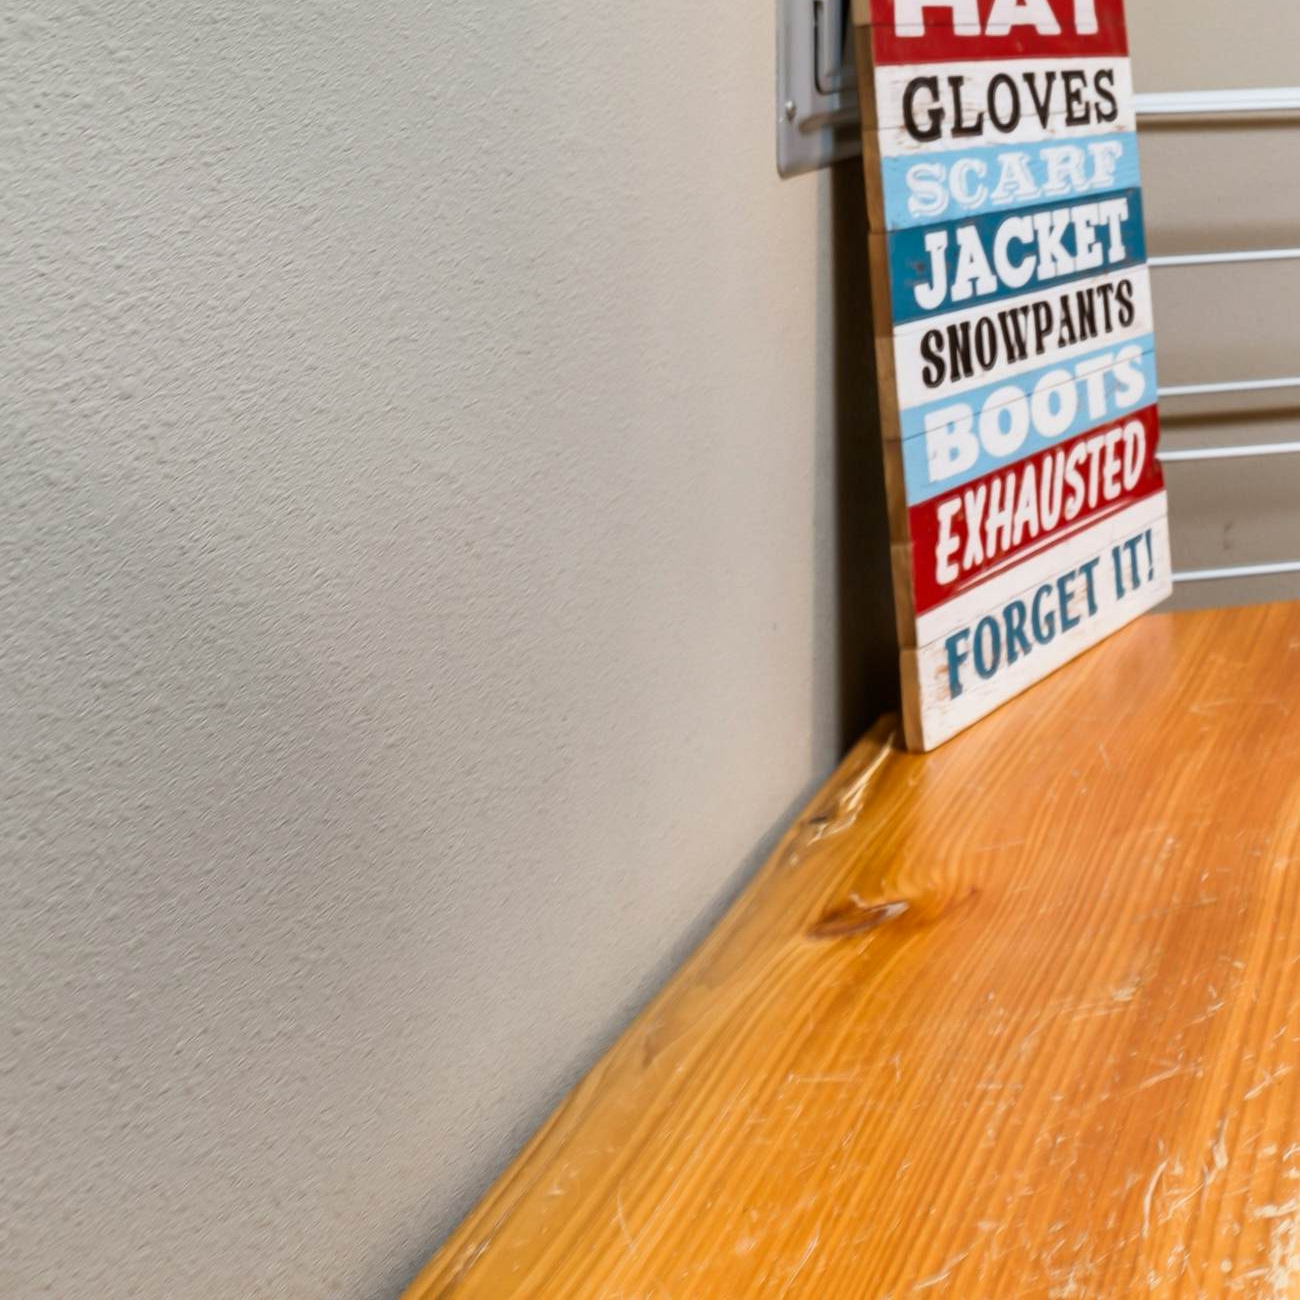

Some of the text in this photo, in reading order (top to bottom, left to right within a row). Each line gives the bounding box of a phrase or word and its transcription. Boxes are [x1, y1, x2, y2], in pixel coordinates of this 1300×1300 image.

[902, 68, 1119, 142] GLOVES
[905, 139, 1124, 218] SCARF
[914, 197, 1128, 310] JACKET
[919, 279, 1135, 388] SNOWPANTS
[924, 344, 1146, 483] BOOTS
[935, 420, 1146, 586] EXHAUSTED
[944, 528, 1155, 701] FORGET IT!
